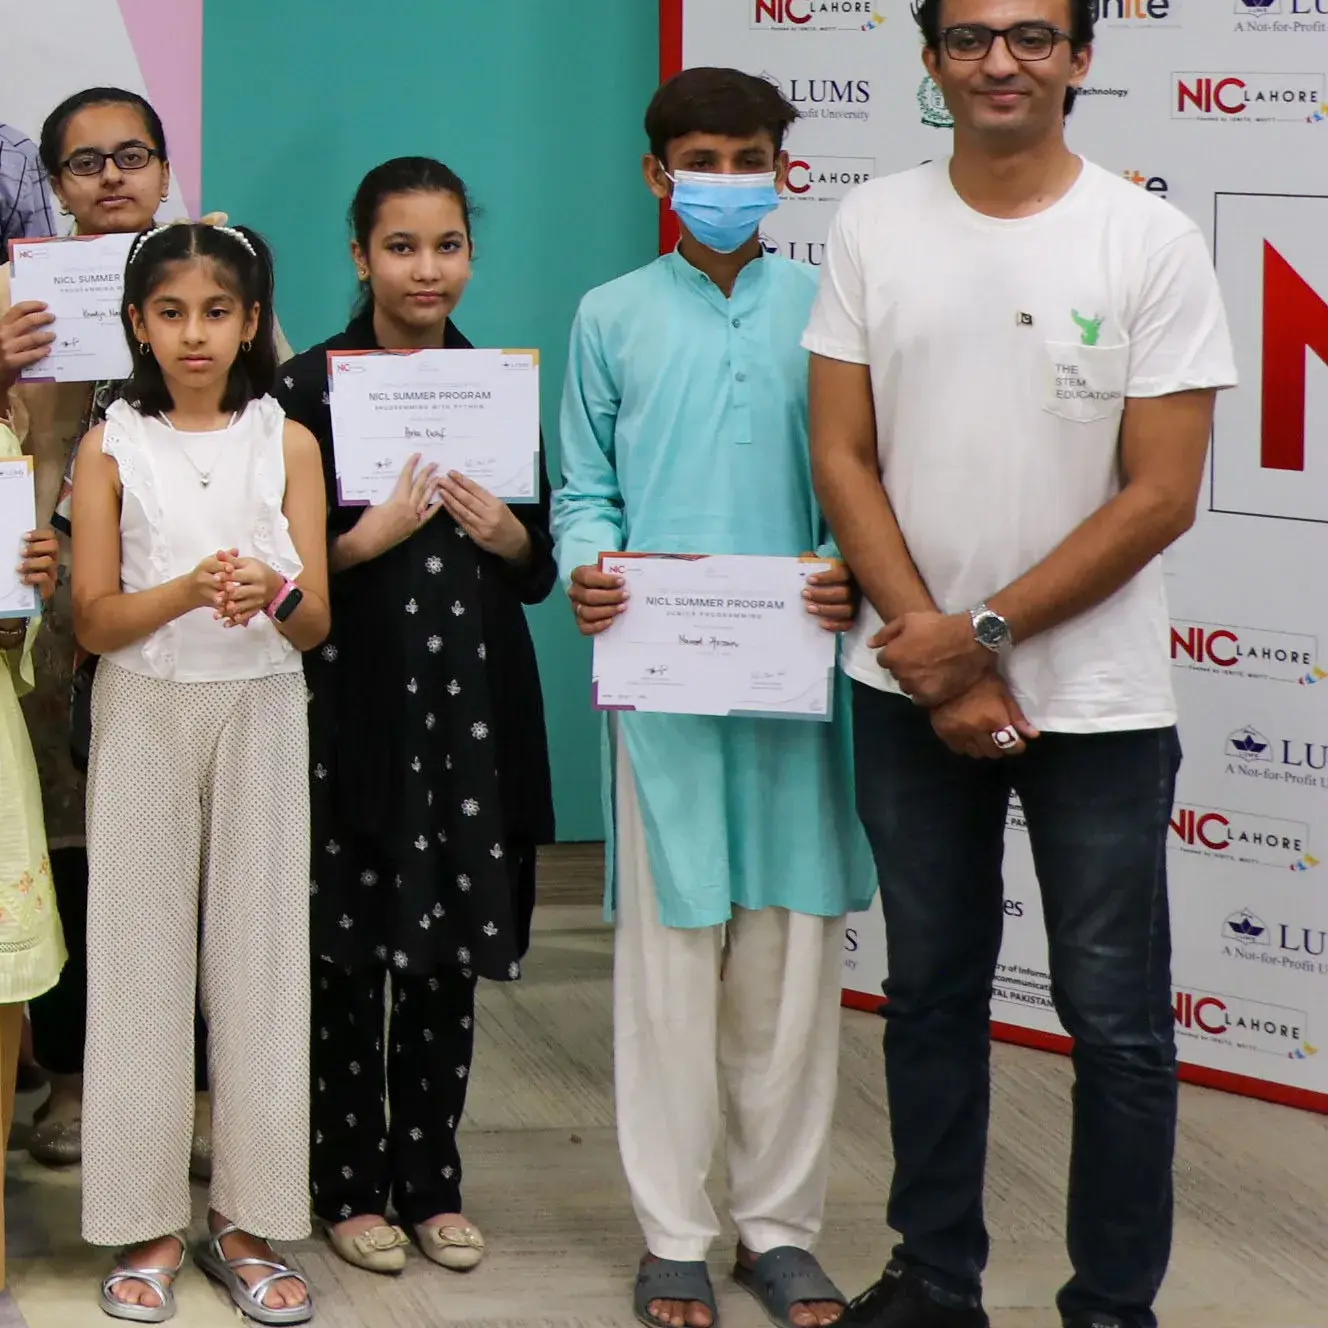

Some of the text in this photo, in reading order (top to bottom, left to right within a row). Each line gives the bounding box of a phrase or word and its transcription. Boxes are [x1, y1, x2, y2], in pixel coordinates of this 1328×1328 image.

[811, 2, 870, 12] LAHORE
[1234, 22, 1326, 32] A Not-for-Profit
[791, 80, 870, 103] LUMS
[1178, 78, 1316, 113] NIC LAHORE
[821, 110, 869, 120] University
[54, 274, 120, 284] NICL SUMMER
[1056, 364, 1078, 374] THE
[1056, 377, 1086, 387] STEM
[369, 392, 491, 401] NICL SUMMER PROGRAM
[646, 596, 784, 609] NICL SUMMER PROGRAM
[1170, 627, 1310, 666] NIC LAHORE
[1225, 764, 1316, 786] A Not-for-Profit
[1228, 828, 1301, 851] LAHORE
[1222, 946, 1313, 973] A Not-for-Profit
[1225, 1013, 1300, 1040] LAHORE
